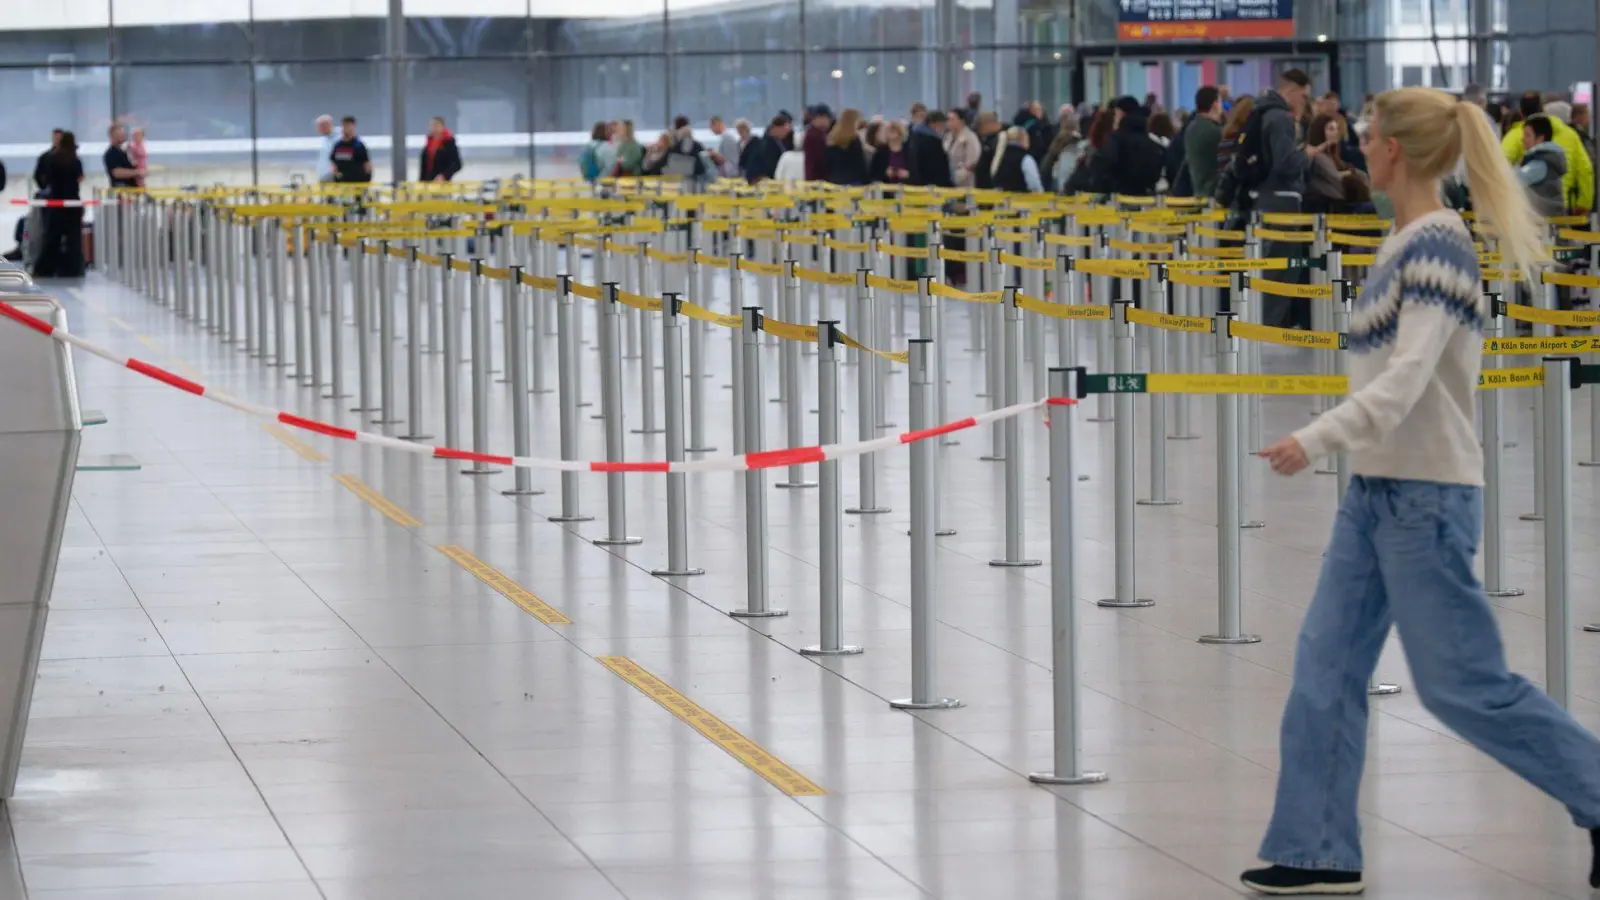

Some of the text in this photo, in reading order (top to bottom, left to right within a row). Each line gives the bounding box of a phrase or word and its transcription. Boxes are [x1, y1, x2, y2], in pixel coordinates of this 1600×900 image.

[1501, 340, 1568, 351] Köln Bonn Airport
[1488, 374, 1507, 384] Köln
[1510, 372, 1530, 383] Bonn
